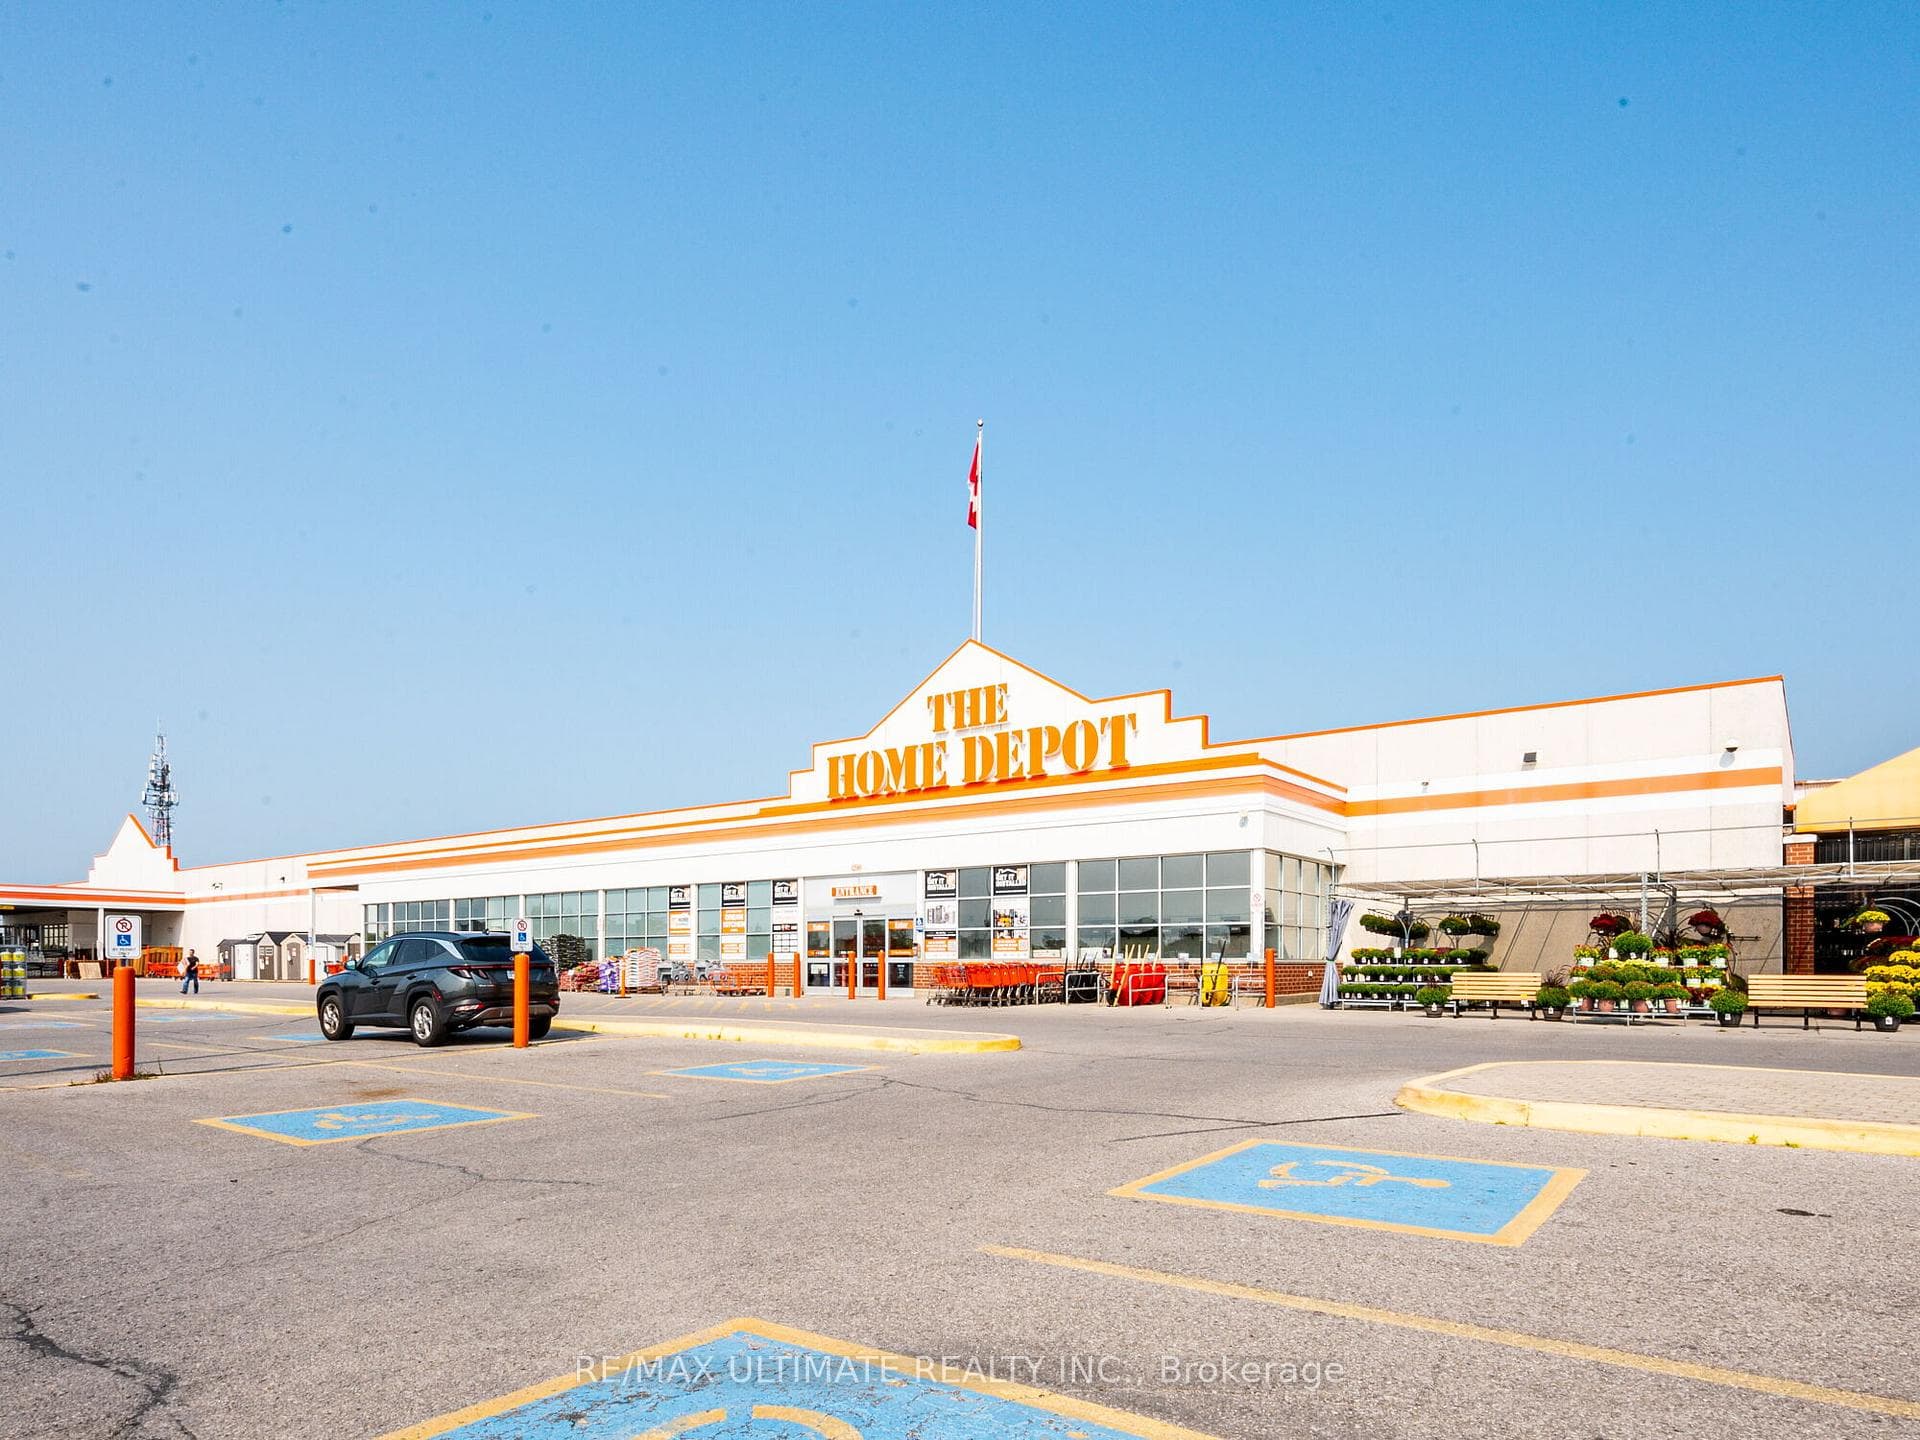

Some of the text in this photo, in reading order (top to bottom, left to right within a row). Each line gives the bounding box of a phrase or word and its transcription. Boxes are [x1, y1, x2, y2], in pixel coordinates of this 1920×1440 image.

[927, 683, 1009, 733] THE
[827, 713, 1137, 799] HOME DEPOT
[836, 886, 873, 896] ENTRANCE
